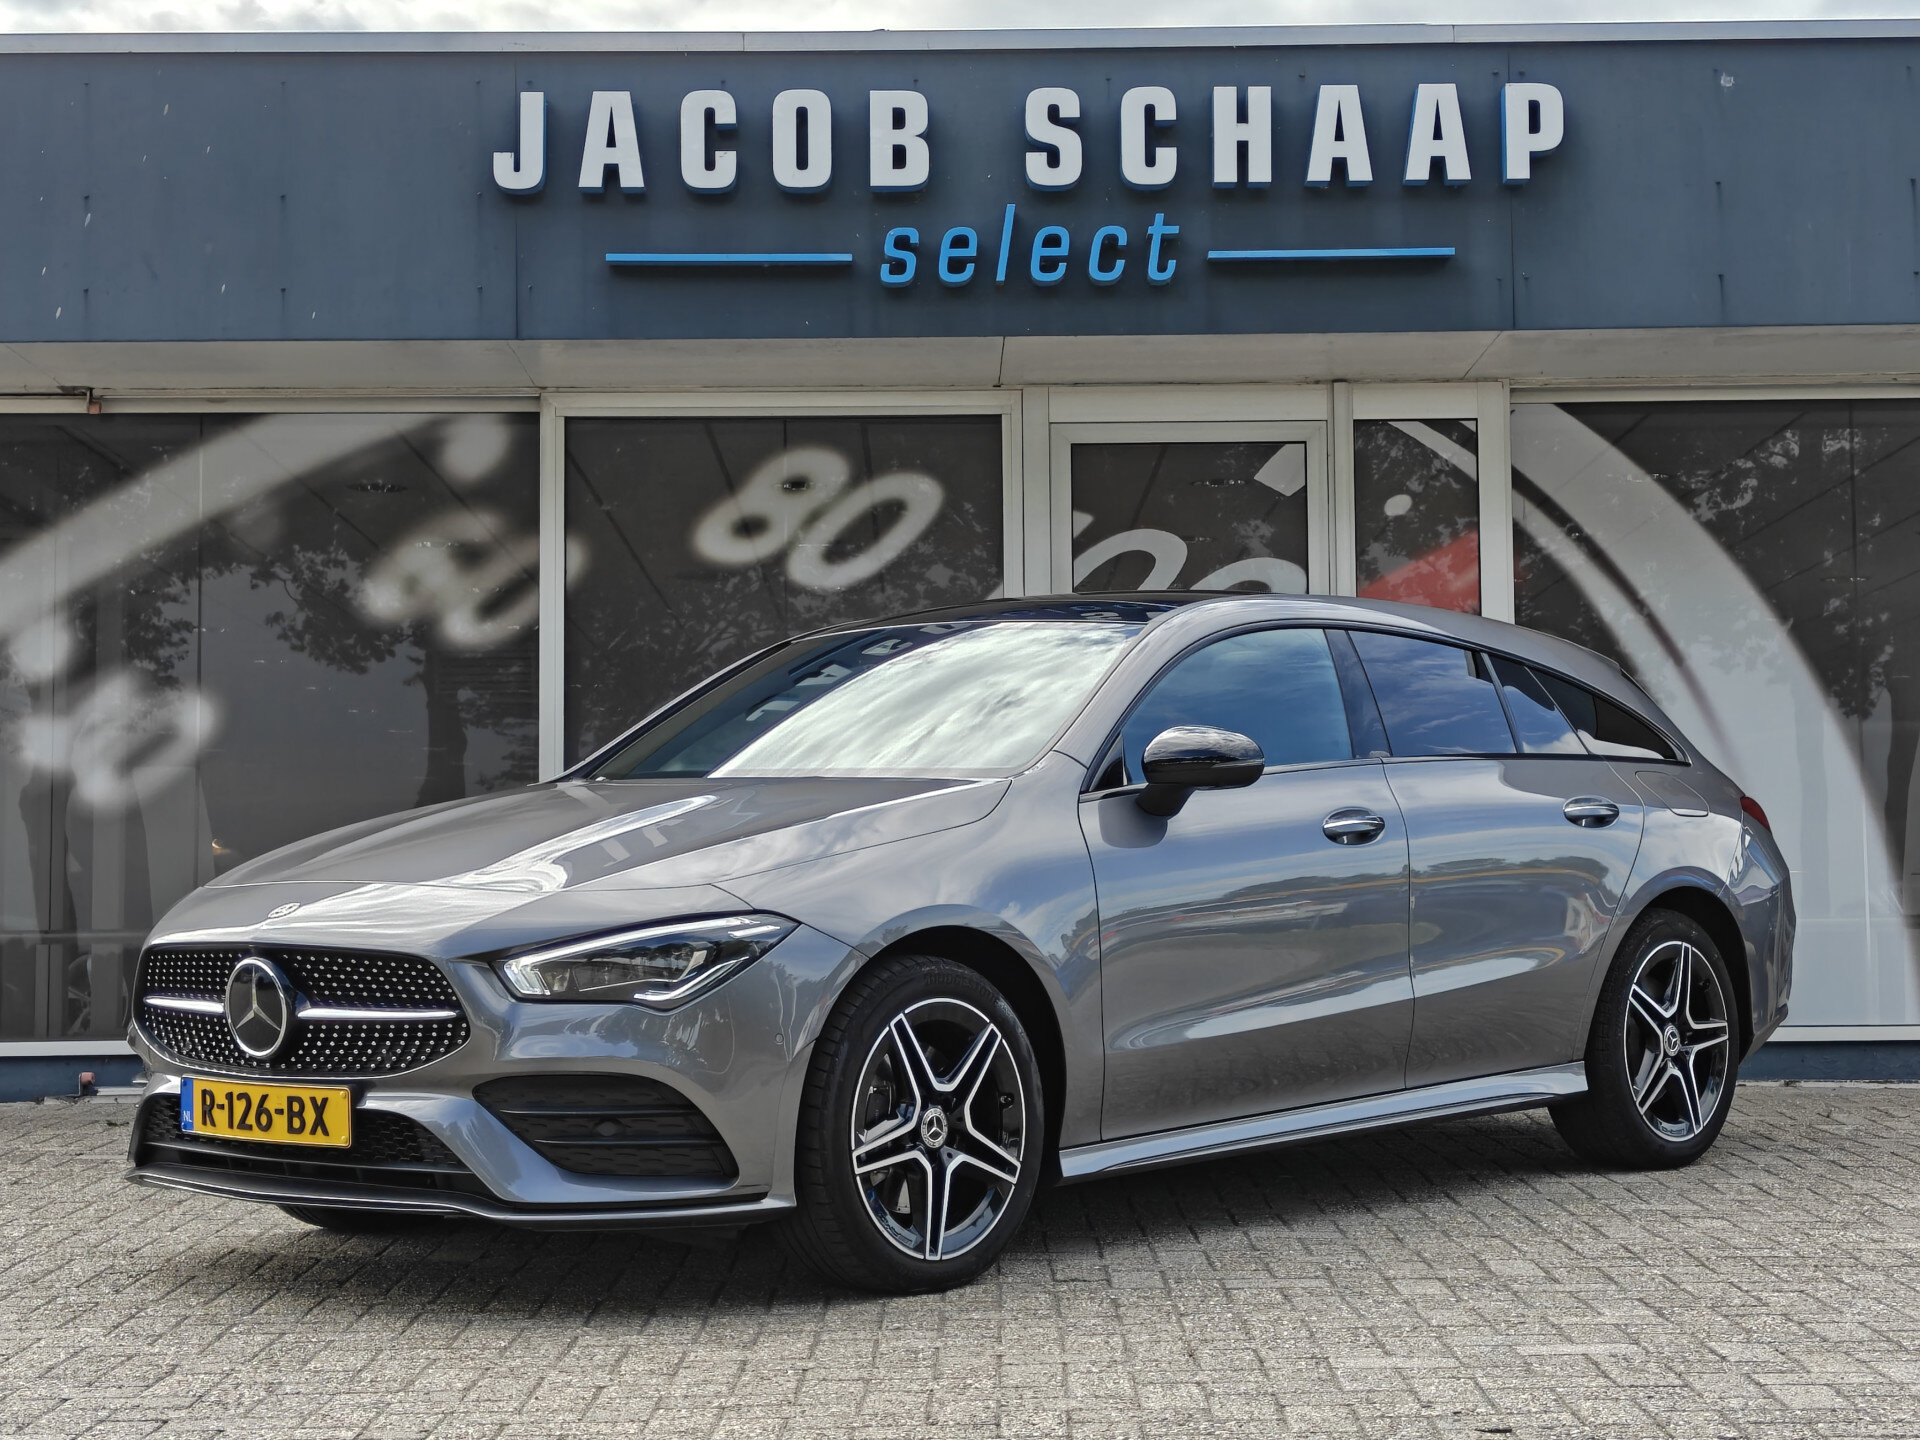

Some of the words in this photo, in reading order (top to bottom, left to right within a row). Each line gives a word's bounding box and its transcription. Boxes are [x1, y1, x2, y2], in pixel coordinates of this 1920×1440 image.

[493, 89, 930, 193] JACOB
[1024, 83, 1565, 190] SCHAAP
[880, 203, 1179, 287] select
[692, 445, 945, 591] 80
[183, 1110, 192, 1122] NL
[201, 1088, 329, 1136] R-126-BX
